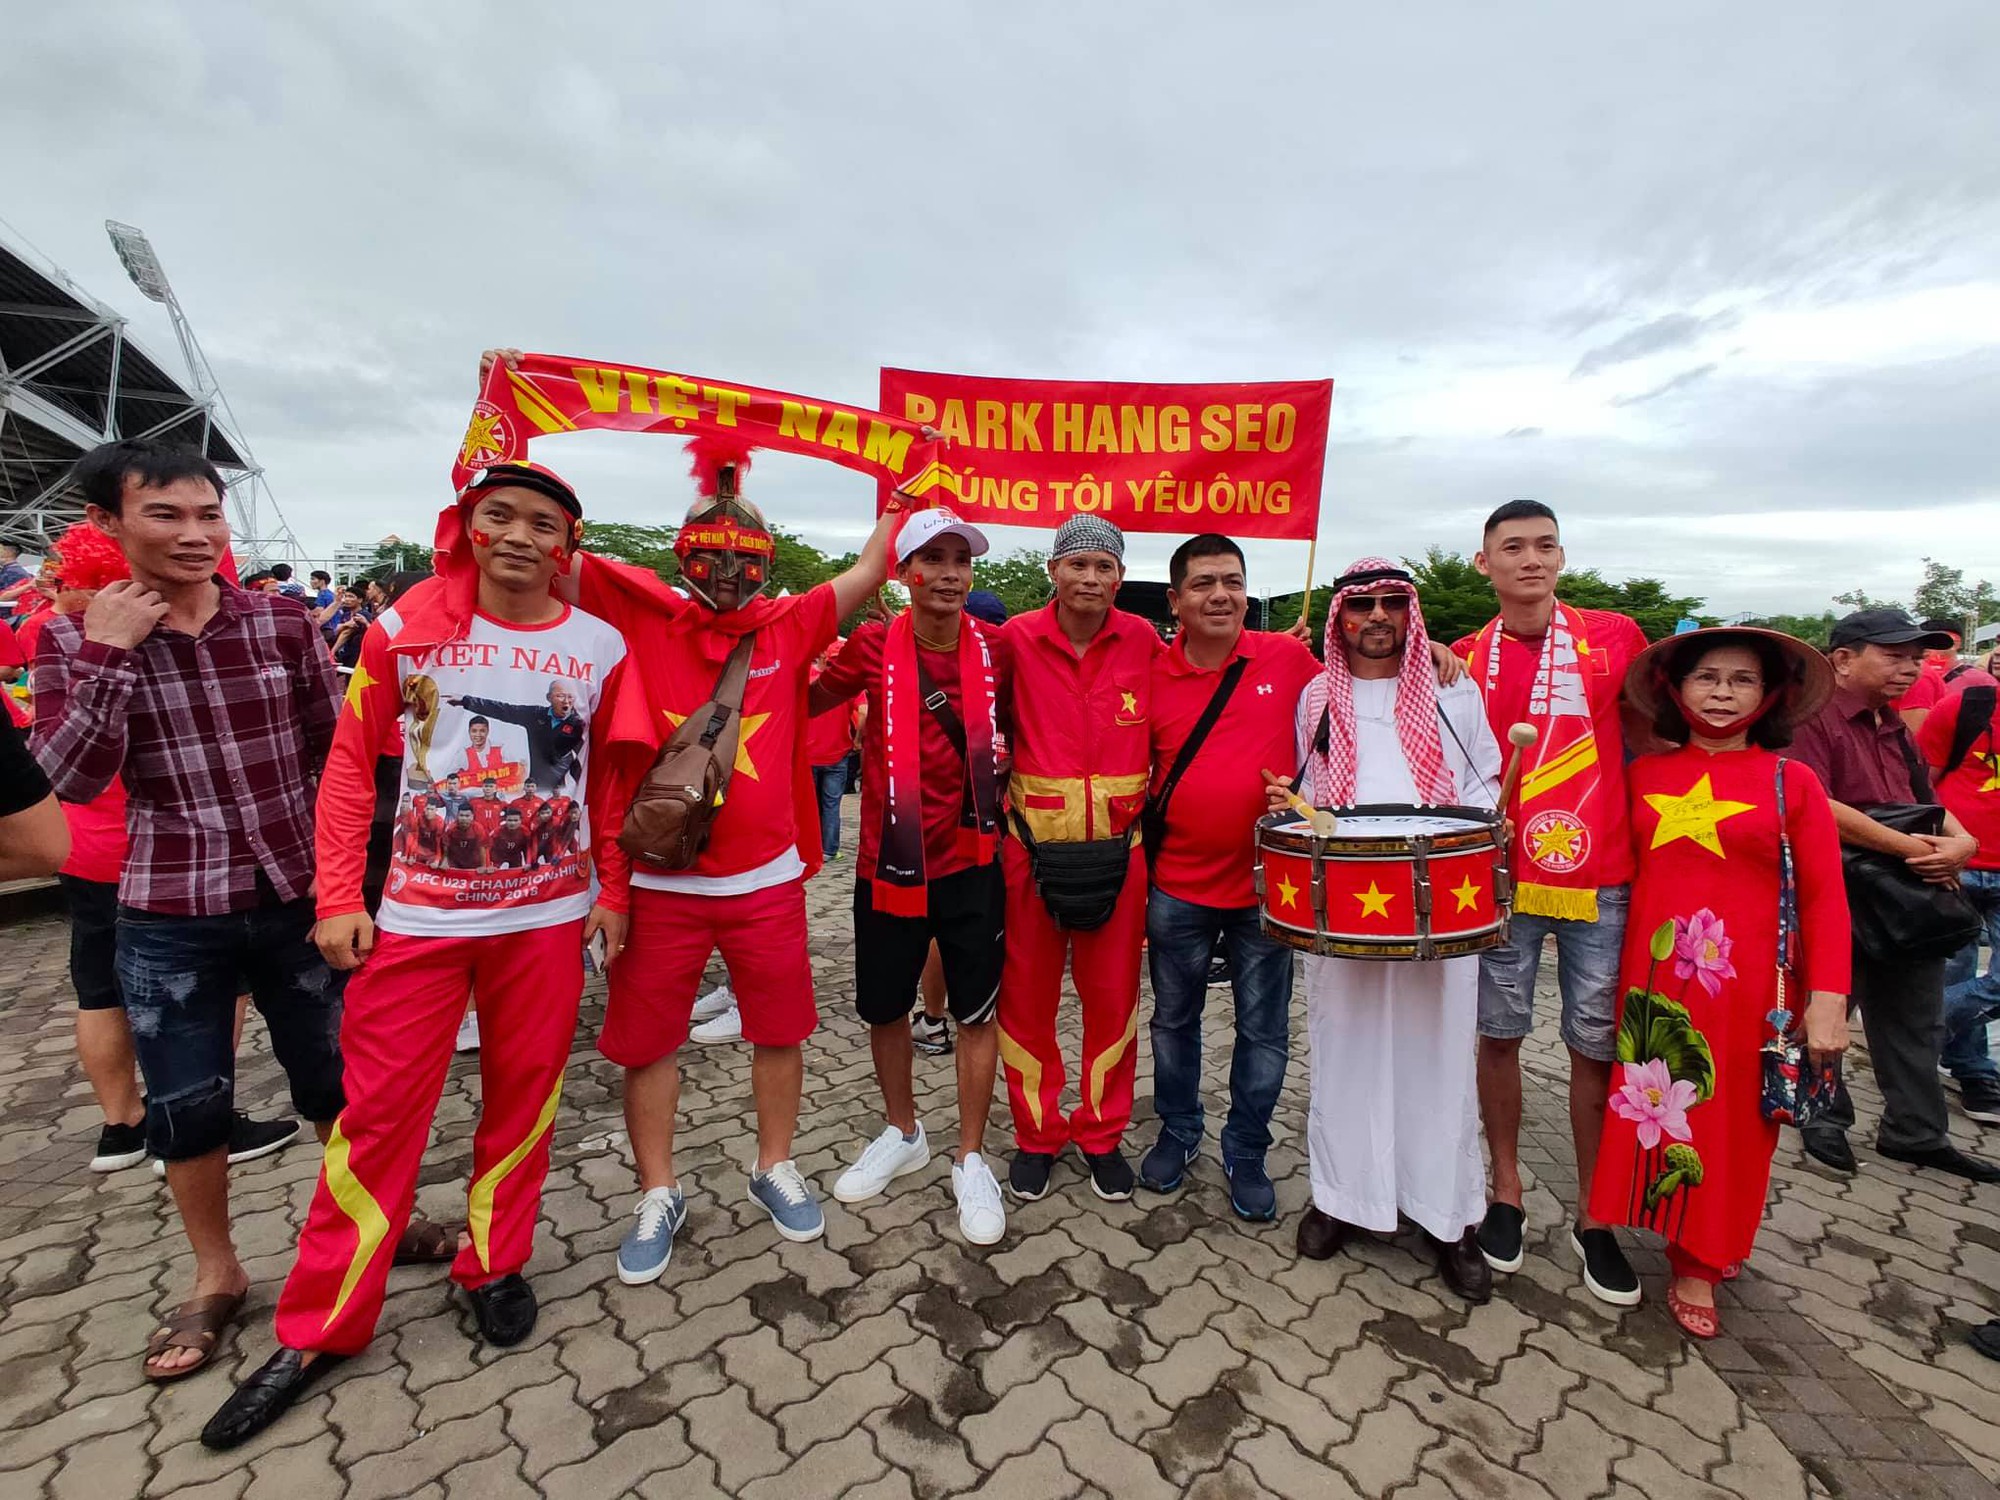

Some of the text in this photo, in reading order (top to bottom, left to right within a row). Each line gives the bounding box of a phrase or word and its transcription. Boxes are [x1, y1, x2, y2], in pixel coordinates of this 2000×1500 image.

[572, 367, 917, 474] VIỆT NAM
[905, 392, 1297, 453] PARK HANG SEO
[956, 469, 1038, 511] ÚNG
[1049, 473, 1112, 512] TÔI
[510, 647, 594, 682] NAM
[411, 874, 439, 885] AFC
[442, 877, 466, 889] U23
[455, 892, 500, 902] CHINA
